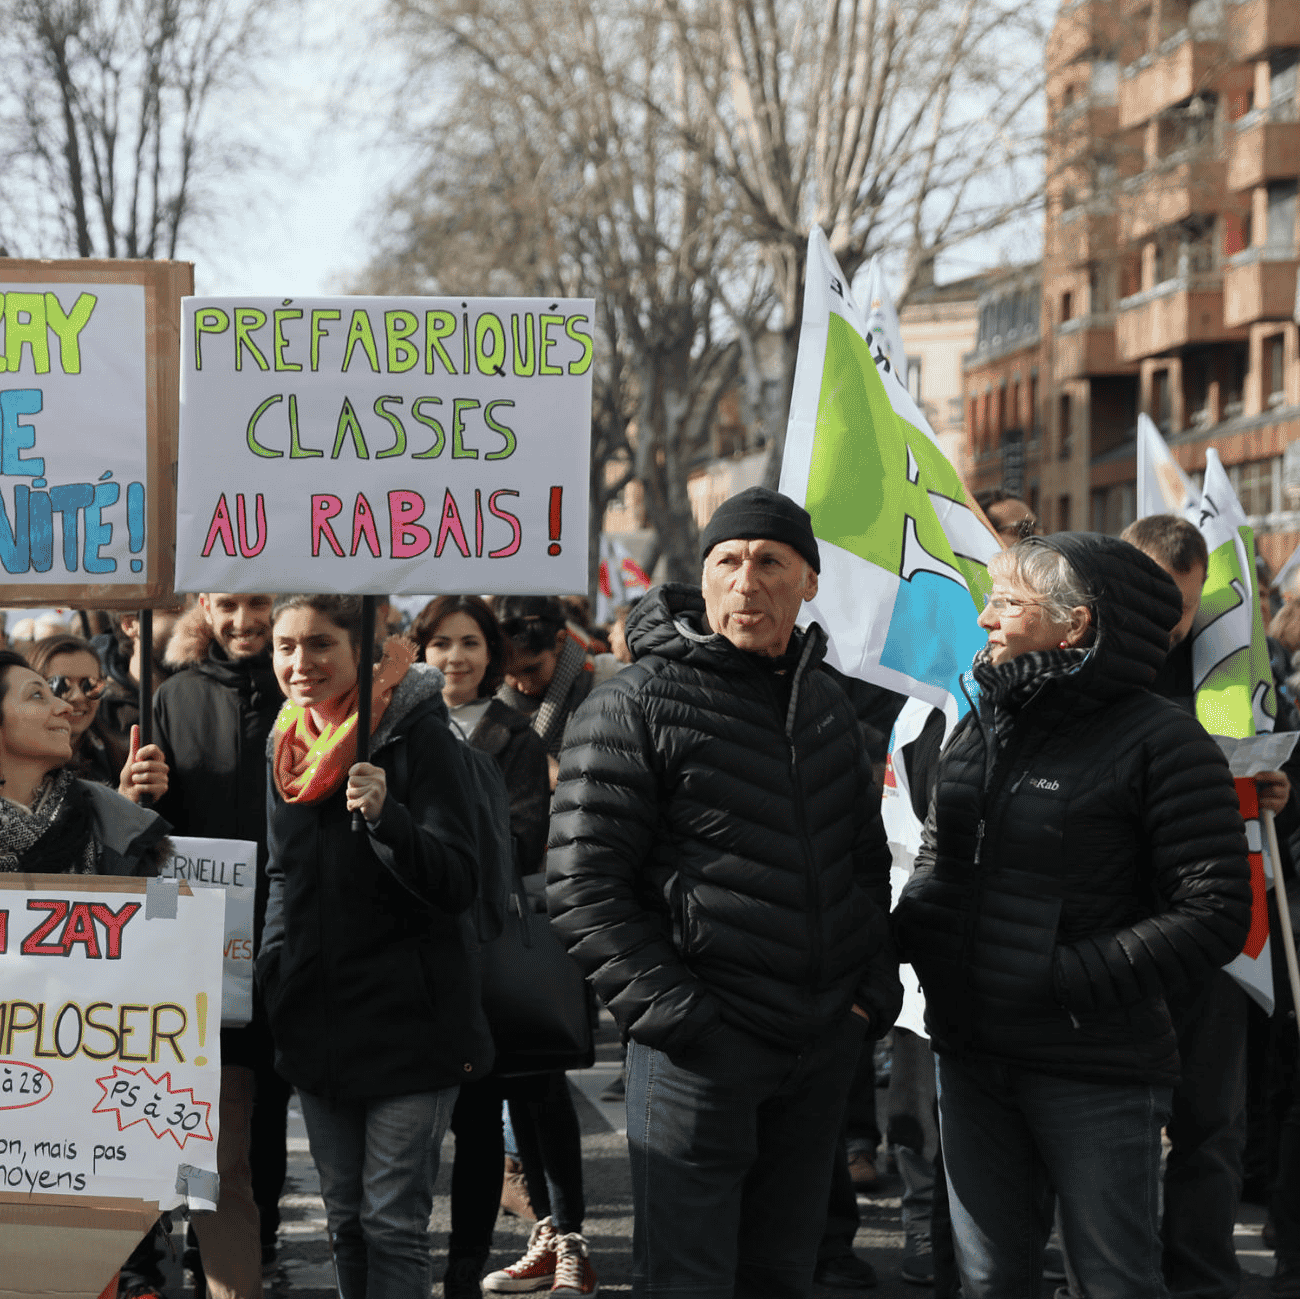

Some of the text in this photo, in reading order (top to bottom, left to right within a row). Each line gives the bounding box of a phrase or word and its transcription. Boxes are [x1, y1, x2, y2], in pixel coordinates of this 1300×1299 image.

[194, 298, 594, 377] PRÉFABRIQUÉS
[246, 394, 518, 461] CLASSES
[201, 492, 268, 558] AU
[310, 487, 521, 559] RABAIS
[1036, 778, 1060, 791] Rab
[20, 898, 142, 960] ZAY
[2, 1068, 13, 1093] à
[19, 1071, 44, 1094] 28
[110, 1080, 202, 1131] PS à 30
[34, 1138, 78, 1160] mais
[94, 1143, 127, 1175] pas
